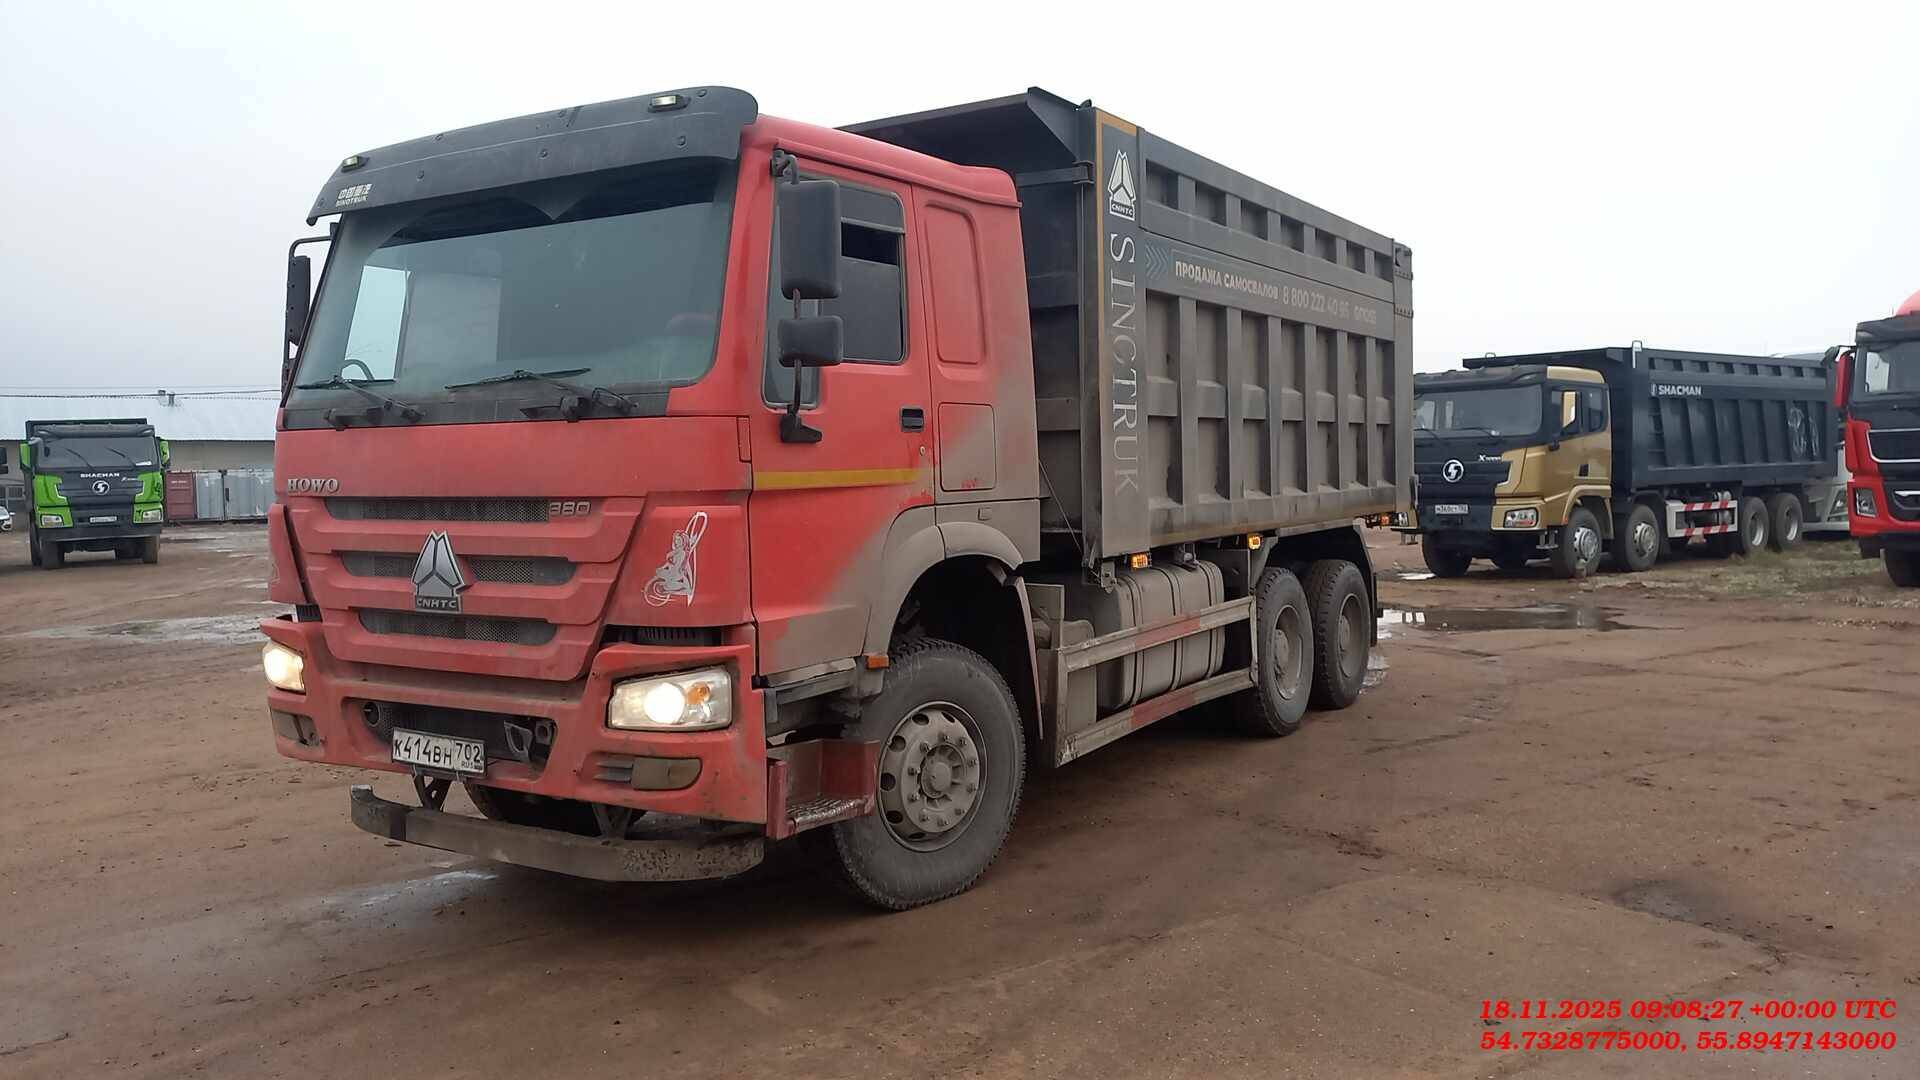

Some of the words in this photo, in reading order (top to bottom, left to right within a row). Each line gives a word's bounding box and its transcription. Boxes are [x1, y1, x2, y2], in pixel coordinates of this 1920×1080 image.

[1175, 260, 1222, 287] ПРОДАЖА
[1224, 272, 1279, 300] САМОСВАЛОВ
[1658, 384, 1702, 396] SHACMAN
[287, 478, 340, 493] HOWO
[416, 597, 457, 609] CNHTC
